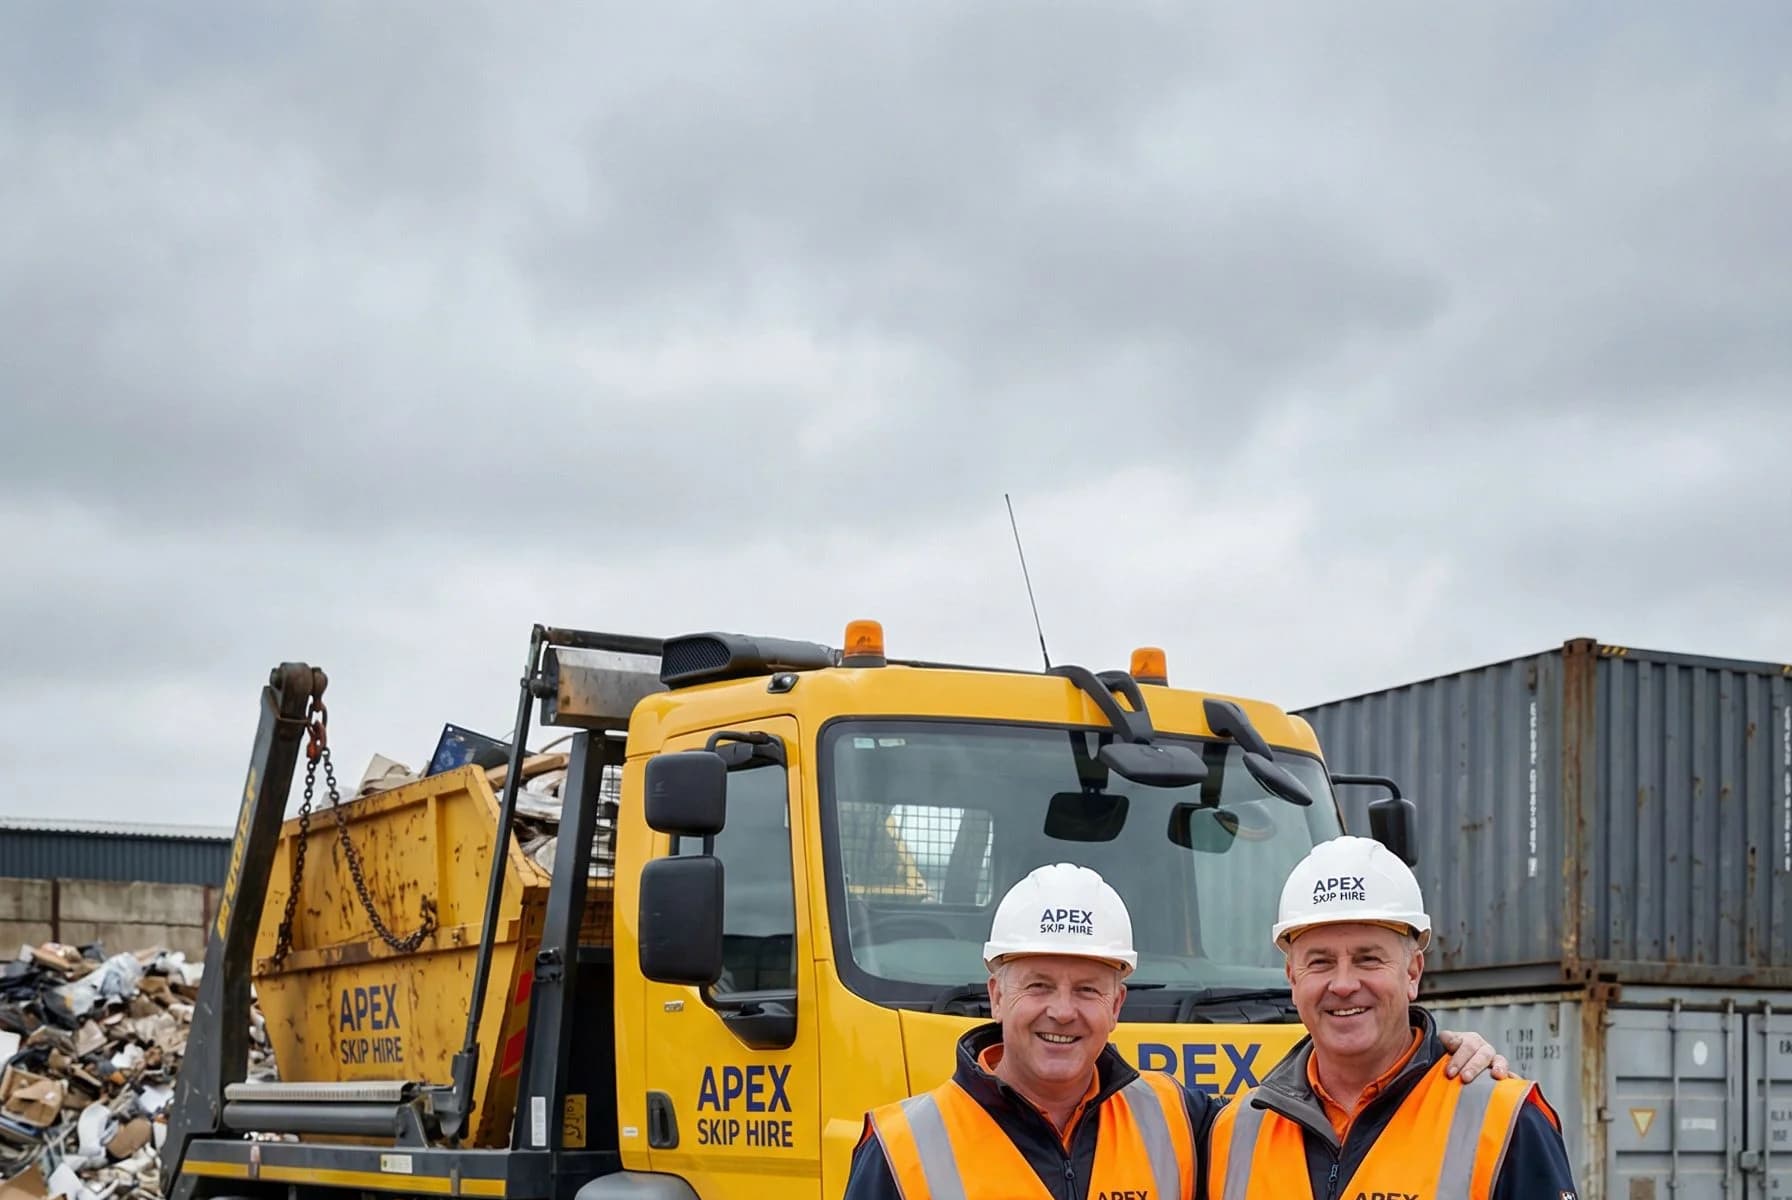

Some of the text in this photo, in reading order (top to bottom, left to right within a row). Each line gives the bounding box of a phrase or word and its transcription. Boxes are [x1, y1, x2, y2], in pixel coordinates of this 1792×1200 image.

[1312, 891, 1366, 904] SKIP HIRE
[1313, 876, 1365, 894] APEX
[1040, 923, 1094, 936] SKIP HIRE
[1041, 908, 1093, 925] APEX
[340, 983, 400, 1032] APEX
[341, 1036, 404, 1064] SKIP HIRE
[1112, 1043, 1262, 1095] PEX
[697, 1065, 792, 1112] APEX
[697, 1118, 793, 1147] SKIP HIRE
